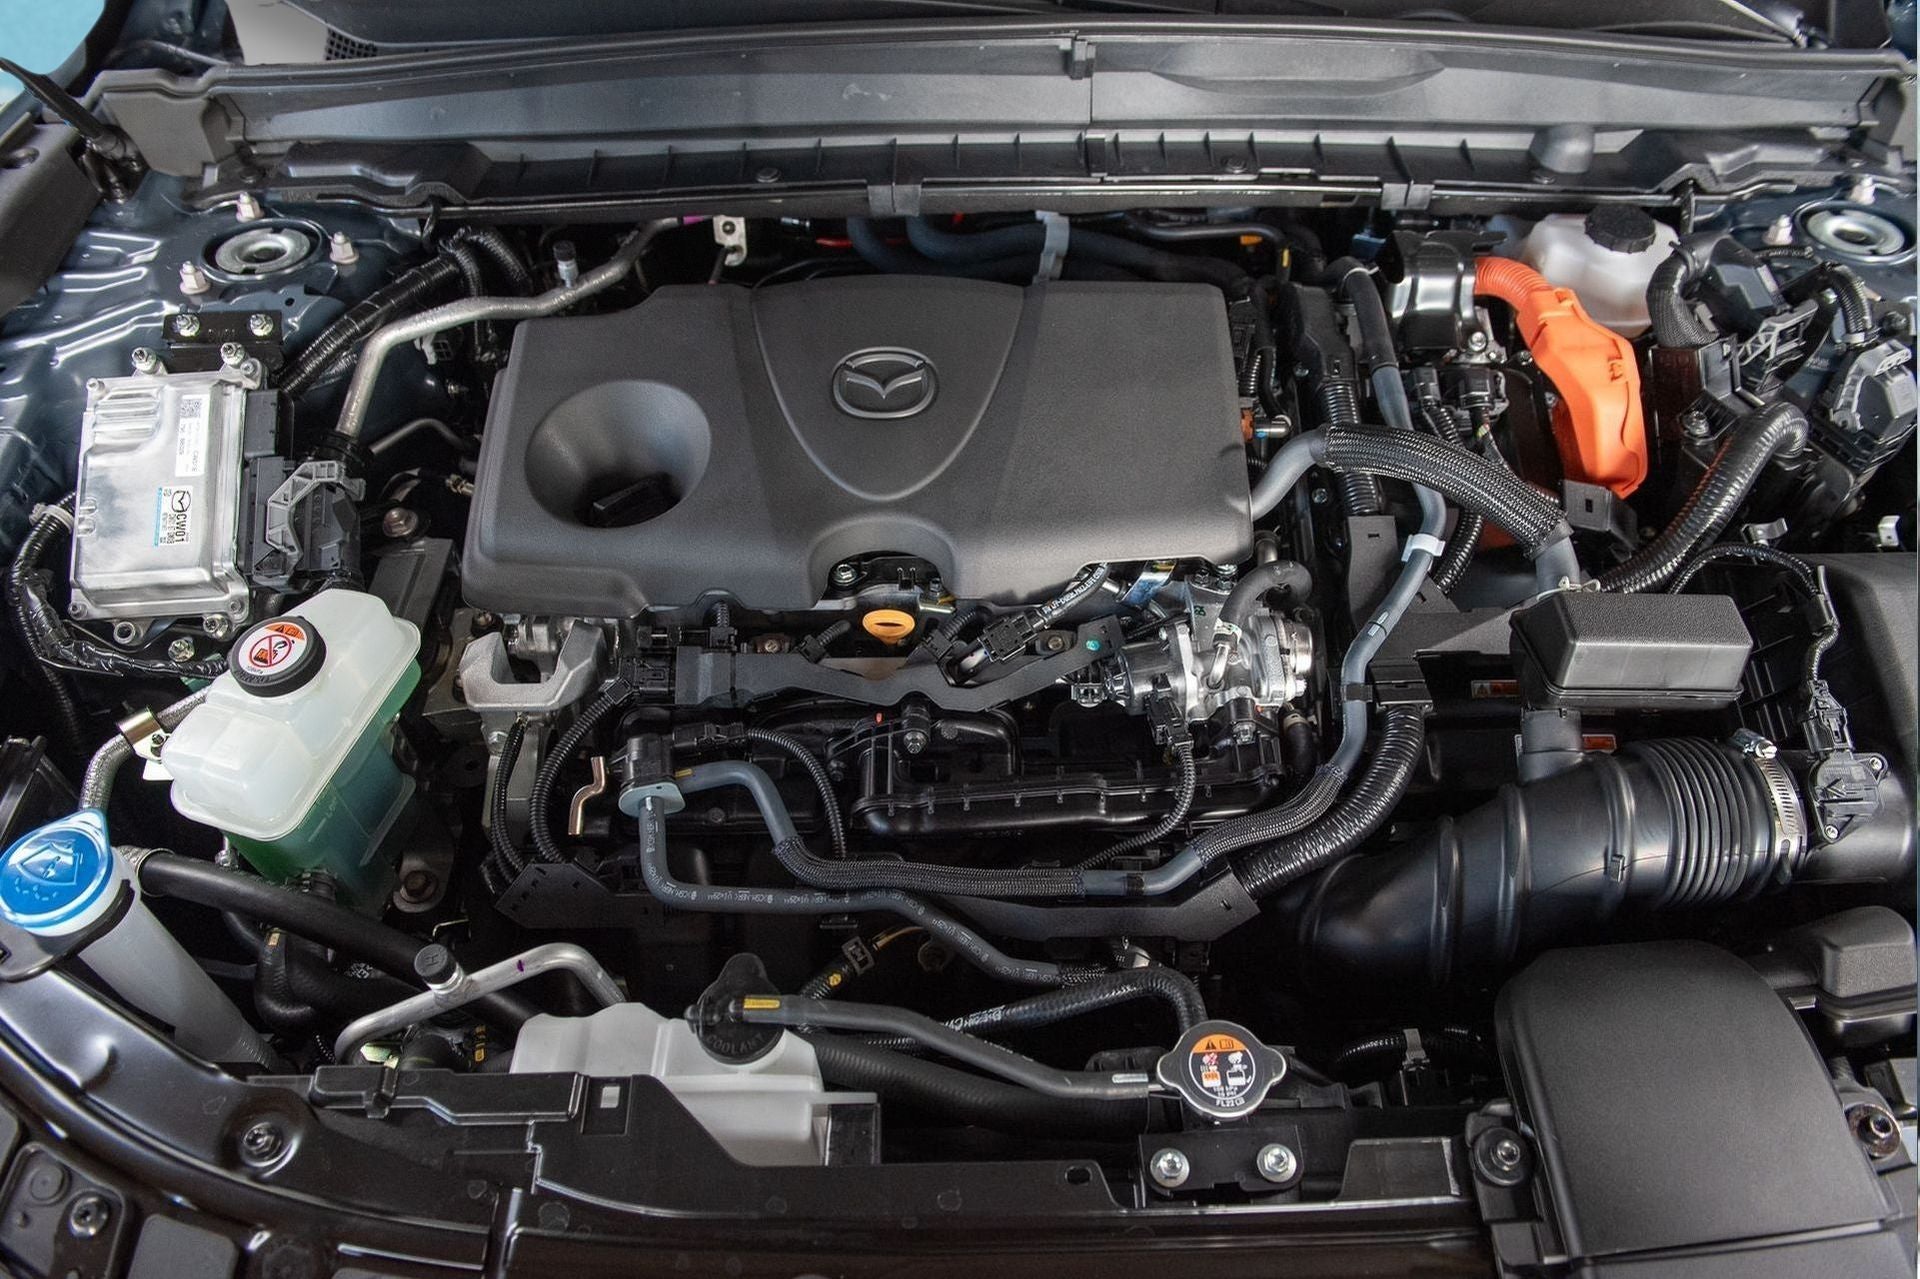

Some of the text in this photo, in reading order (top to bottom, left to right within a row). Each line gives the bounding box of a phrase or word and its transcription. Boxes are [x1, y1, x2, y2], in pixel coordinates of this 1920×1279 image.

[175, 513, 187, 543] CW01
[706, 1032, 765, 1054] COOLANT
[1216, 1099, 1234, 1107] FL22
